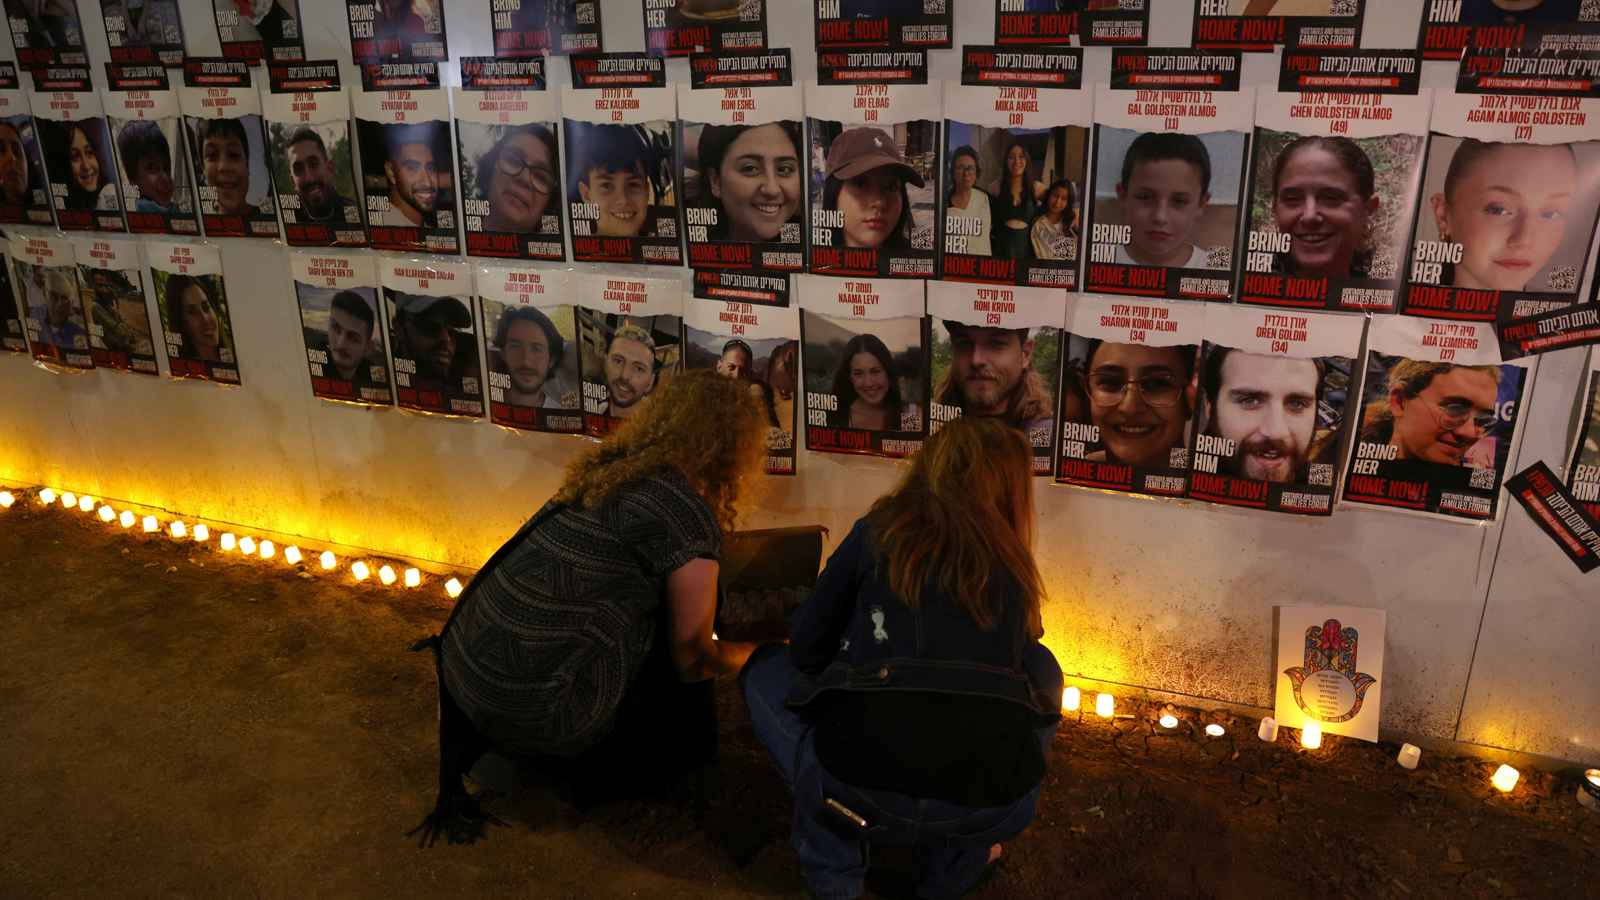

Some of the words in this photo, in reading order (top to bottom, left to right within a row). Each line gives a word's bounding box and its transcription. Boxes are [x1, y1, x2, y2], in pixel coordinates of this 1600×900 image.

[349, 4, 375, 21] BRING
[819, 0, 840, 19] HIM
[1201, 0, 1228, 16] HER
[1428, 0, 1462, 22] HIM
[494, 12, 512, 29] HIM
[646, 10, 666, 28] HER
[1000, 14, 1036, 34] HOME
[1040, 12, 1078, 34] NOW!
[351, 21, 375, 39] THEM
[1200, 19, 1237, 40] HOME
[1242, 16, 1285, 40] NOW!
[1424, 26, 1468, 48] HOME
[894, 52, 923, 67] מחזירים
[995, 53, 1021, 69] הביתה
[1023, 54, 1044, 70] אותם
[1046, 54, 1077, 70] מחזירים
[1148, 55, 1175, 70] הביתה
[1177, 55, 1199, 71] אותם
[1203, 55, 1236, 71] מחזירים
[1320, 57, 1350, 73] הביתה
[1351, 57, 1377, 73] אותם
[1380, 57, 1415, 73] מחזירים
[1503, 57, 1538, 75] הביתה
[1538, 58, 1565, 75] אותם
[611, 100, 639, 110] KALDERON
[721, 100, 737, 110] RONI
[737, 100, 756, 110] ESHEL
[853, 97, 867, 108] LIRI
[868, 97, 890, 109] ELBAG
[995, 100, 1014, 111] MIKA
[1015, 101, 1039, 112] ANGEL
[1127, 103, 1142, 115] GAL
[1144, 104, 1186, 117] GOLDSTEIN
[1188, 105, 1216, 118] ALMOG
[1009, 112, 1024, 125] (18)
[1290, 106, 1312, 118] CHEN
[1314, 106, 1359, 119] GOLDSTEIN
[1361, 107, 1392, 120] ALMOG
[1467, 110, 1495, 122] AGAM
[1497, 111, 1531, 124] ALMOG
[1532, 112, 1586, 126] GOLDSTEIN
[1164, 117, 1179, 130] (11)
[1329, 120, 1348, 134] (49)
[1515, 126, 1532, 140] (17)
[465, 200, 490, 216] BRING
[571, 202, 600, 220] BRING
[686, 207, 718, 225] BRING
[812, 209, 844, 229] BRING
[945, 215, 981, 237] BRING
[573, 220, 591, 236] HIM
[688, 225, 709, 243] HER
[1092, 223, 1131, 245] BRING
[812, 228, 833, 246] HER
[945, 235, 969, 255] HER
[1248, 231, 1291, 253] BRING
[1090, 243, 1117, 263] HIM
[1415, 240, 1464, 264] BRING
[944, 255, 977, 275] HOME
[982, 257, 1016, 279] NOW!
[1246, 252, 1273, 273] HER
[1090, 265, 1125, 286] HOME
[1129, 267, 1167, 289] NOW!
[1412, 262, 1443, 285] HER
[1244, 274, 1282, 296] HOME
[1285, 275, 1328, 302] NOW!
[838, 294, 862, 304] NAAMA
[863, 294, 880, 305] LEVY
[974, 300, 991, 311] RONI
[991, 302, 1016, 313] KRIVOI
[1408, 286, 1452, 308] HOME
[1456, 289, 1501, 312] NOW!
[986, 313, 1001, 325] (25)
[1100, 316, 1131, 328] SHARON
[1132, 319, 1154, 330] KONIO
[1155, 320, 1178, 333] ALONI
[1537, 313, 1570, 334] הביתה
[1130, 330, 1145, 342] (34)
[1256, 326, 1277, 338] OREN
[1278, 328, 1307, 342] GOLDIN
[1422, 335, 1438, 347] MIA
[1439, 336, 1479, 350] LEIMBERG
[1271, 341, 1288, 354] (34)
[1440, 349, 1455, 361] (17)
[583, 380, 607, 400] BRING
[807, 392, 838, 411] BRING
[808, 408, 829, 428] HER
[1063, 421, 1100, 443] BRING
[1062, 440, 1085, 460] HER
[1196, 432, 1235, 457] BRING
[1356, 442, 1399, 461] BRING
[1062, 460, 1095, 479] HOME
[1193, 452, 1219, 474] HIM
[1352, 459, 1380, 476] HER
[1231, 478, 1269, 499] NOW!
[1351, 475, 1386, 495] HOME
[1389, 479, 1430, 502] NOW!
